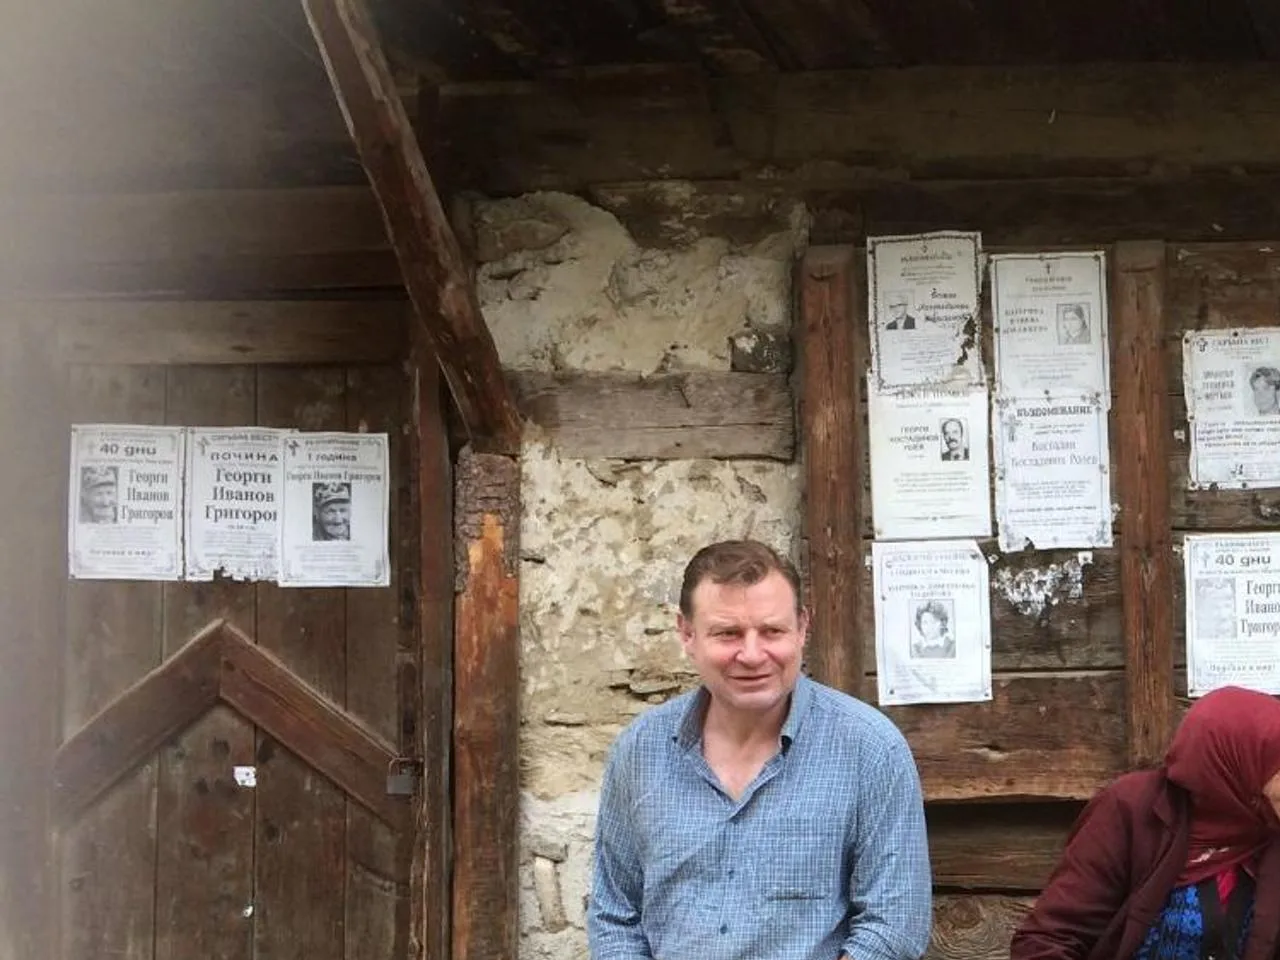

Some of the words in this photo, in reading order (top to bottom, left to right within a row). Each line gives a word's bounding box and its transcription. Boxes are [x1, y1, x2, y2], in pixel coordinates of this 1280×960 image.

[100, 444, 119, 454] 40
[210, 452, 279, 462] ПОЧИНА
[215, 468, 272, 489] Георги
[212, 487, 275, 502] Иванов
[1215, 554, 1235, 565] 40
